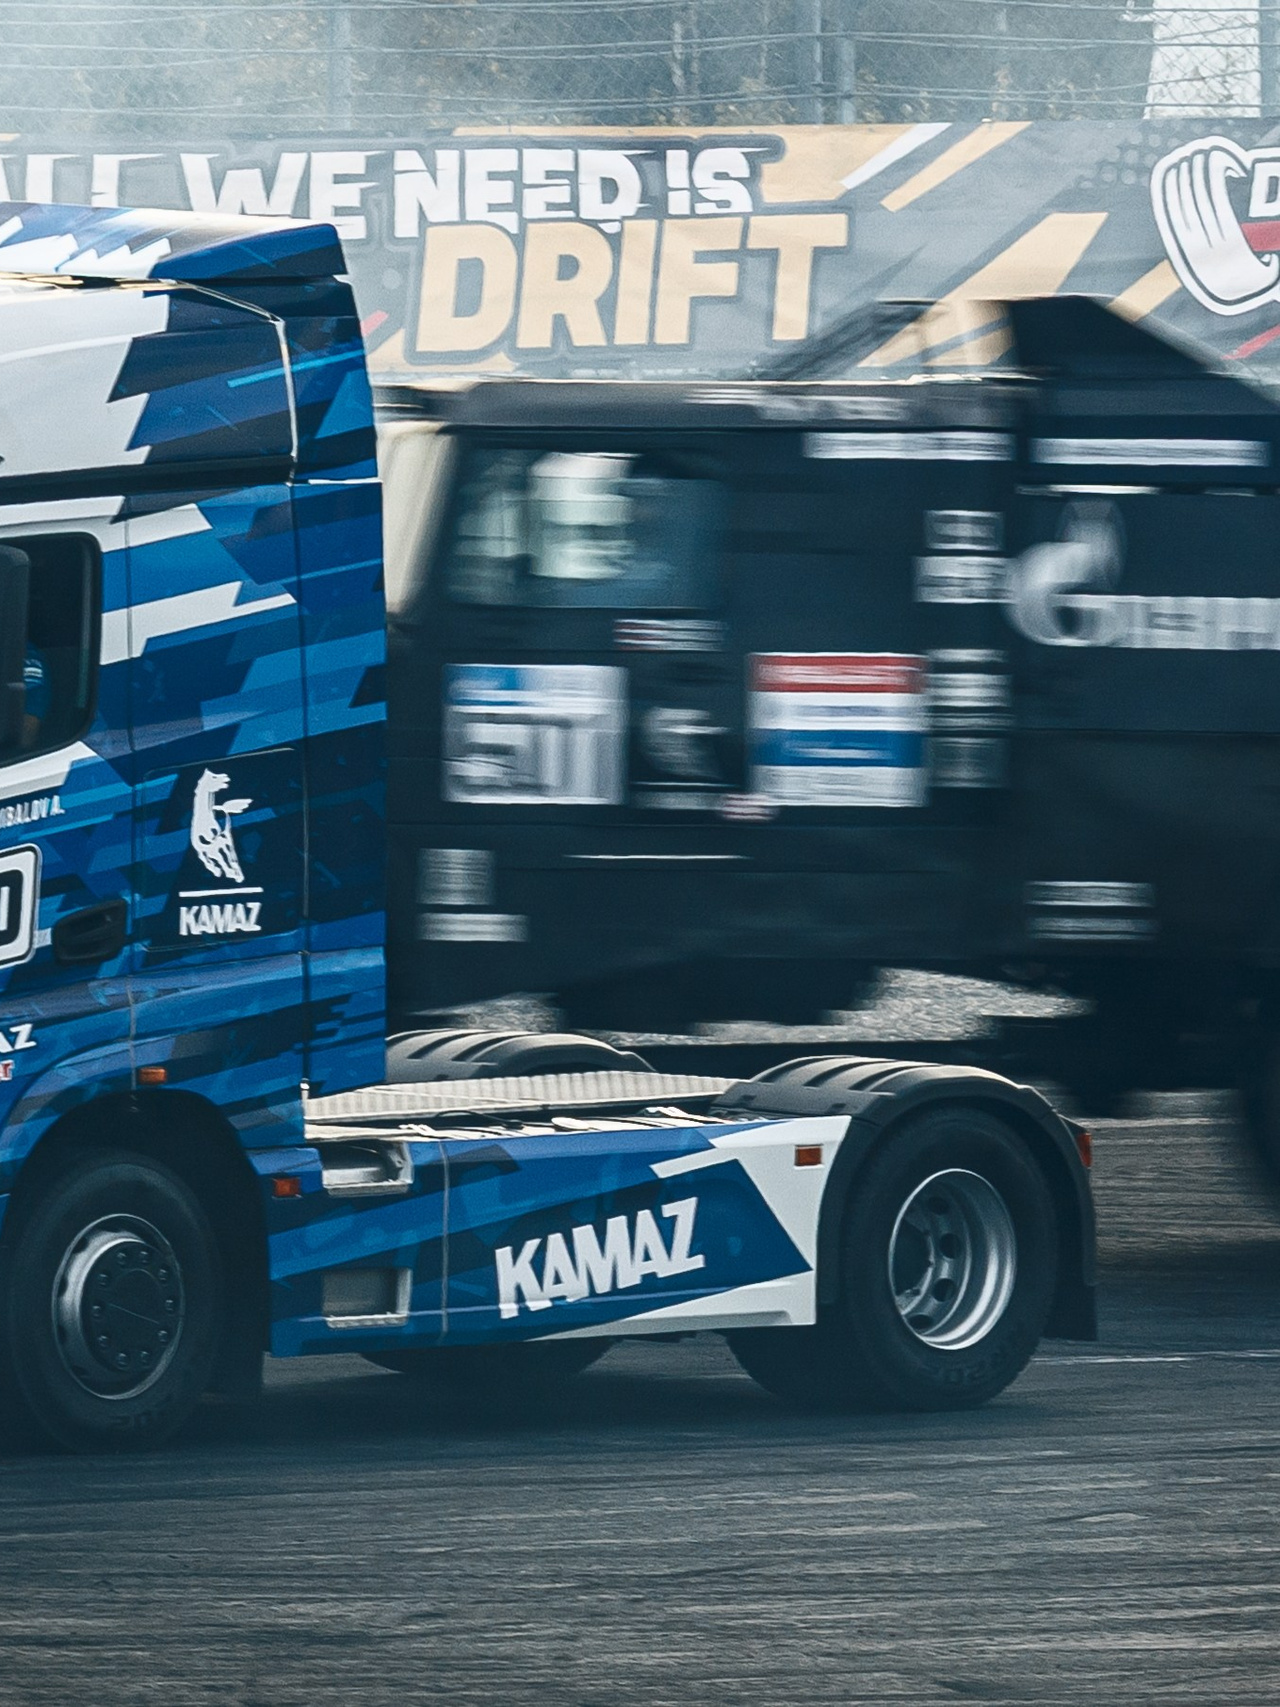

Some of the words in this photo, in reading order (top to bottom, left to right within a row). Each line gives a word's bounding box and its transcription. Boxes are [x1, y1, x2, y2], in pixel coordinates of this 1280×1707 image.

[179, 152, 384, 239] WE
[394, 149, 645, 238] NEED
[666, 148, 764, 216] IS
[415, 213, 848, 353] DRIFT
[179, 902, 262, 936] KAMAZ
[495, 1196, 707, 1320] KAMAZ
